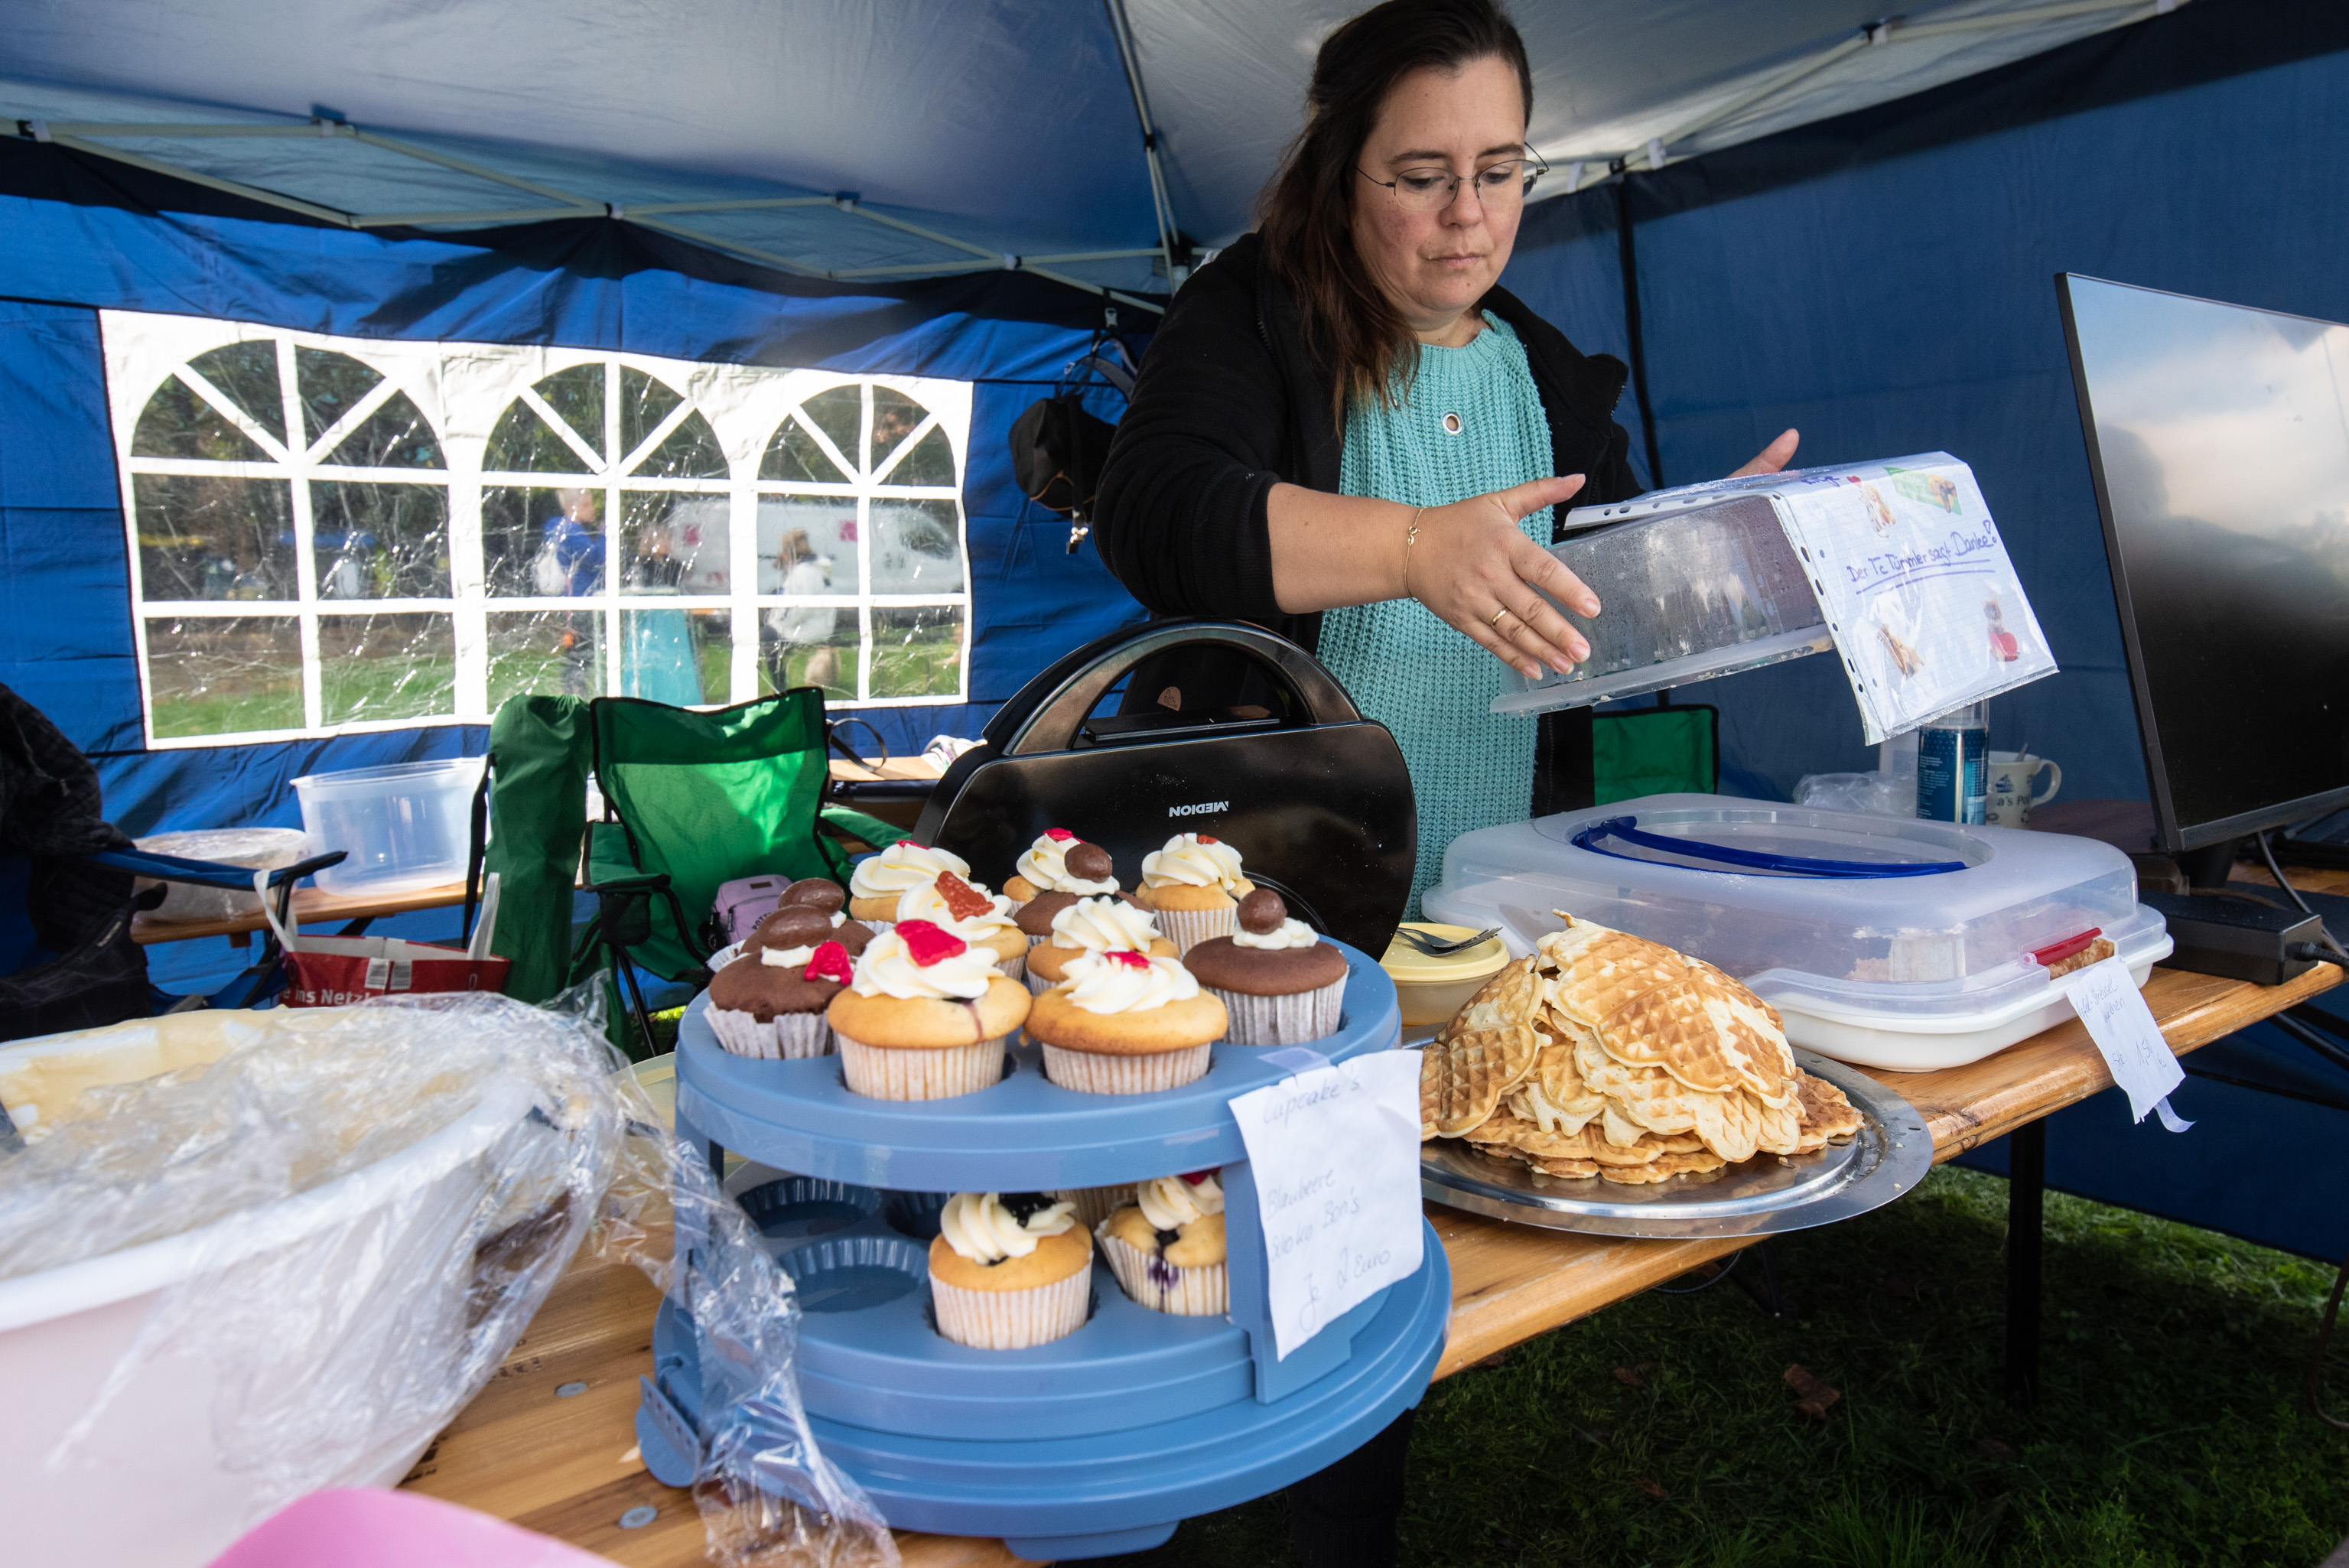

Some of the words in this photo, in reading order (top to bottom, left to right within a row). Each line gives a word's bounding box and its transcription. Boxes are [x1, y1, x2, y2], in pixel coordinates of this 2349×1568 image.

[1928, 541, 1951, 567] sagt
[1169, 801, 1229, 818] MEDION
[1353, 1250, 1391, 1280] Euro
